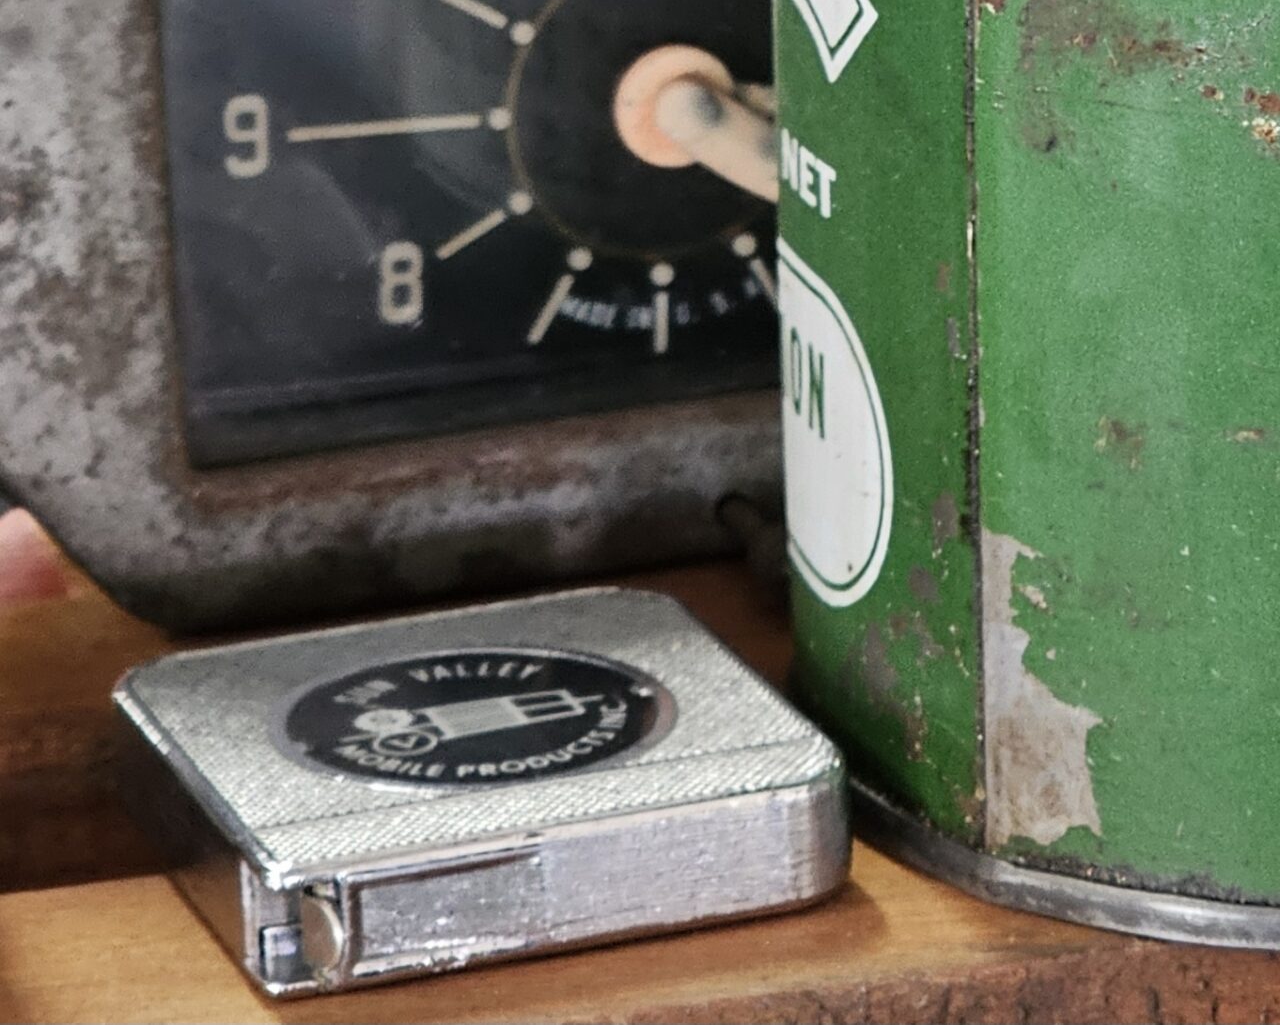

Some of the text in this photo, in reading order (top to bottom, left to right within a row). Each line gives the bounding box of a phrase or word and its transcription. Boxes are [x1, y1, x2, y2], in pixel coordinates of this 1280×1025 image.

[222, 94, 269, 178] 9
[378, 240, 424, 325] 8
[407, 661, 544, 683] VALLEY
[333, 744, 446, 778] MOBILE
[457, 729, 616, 779] PRODUCTS
